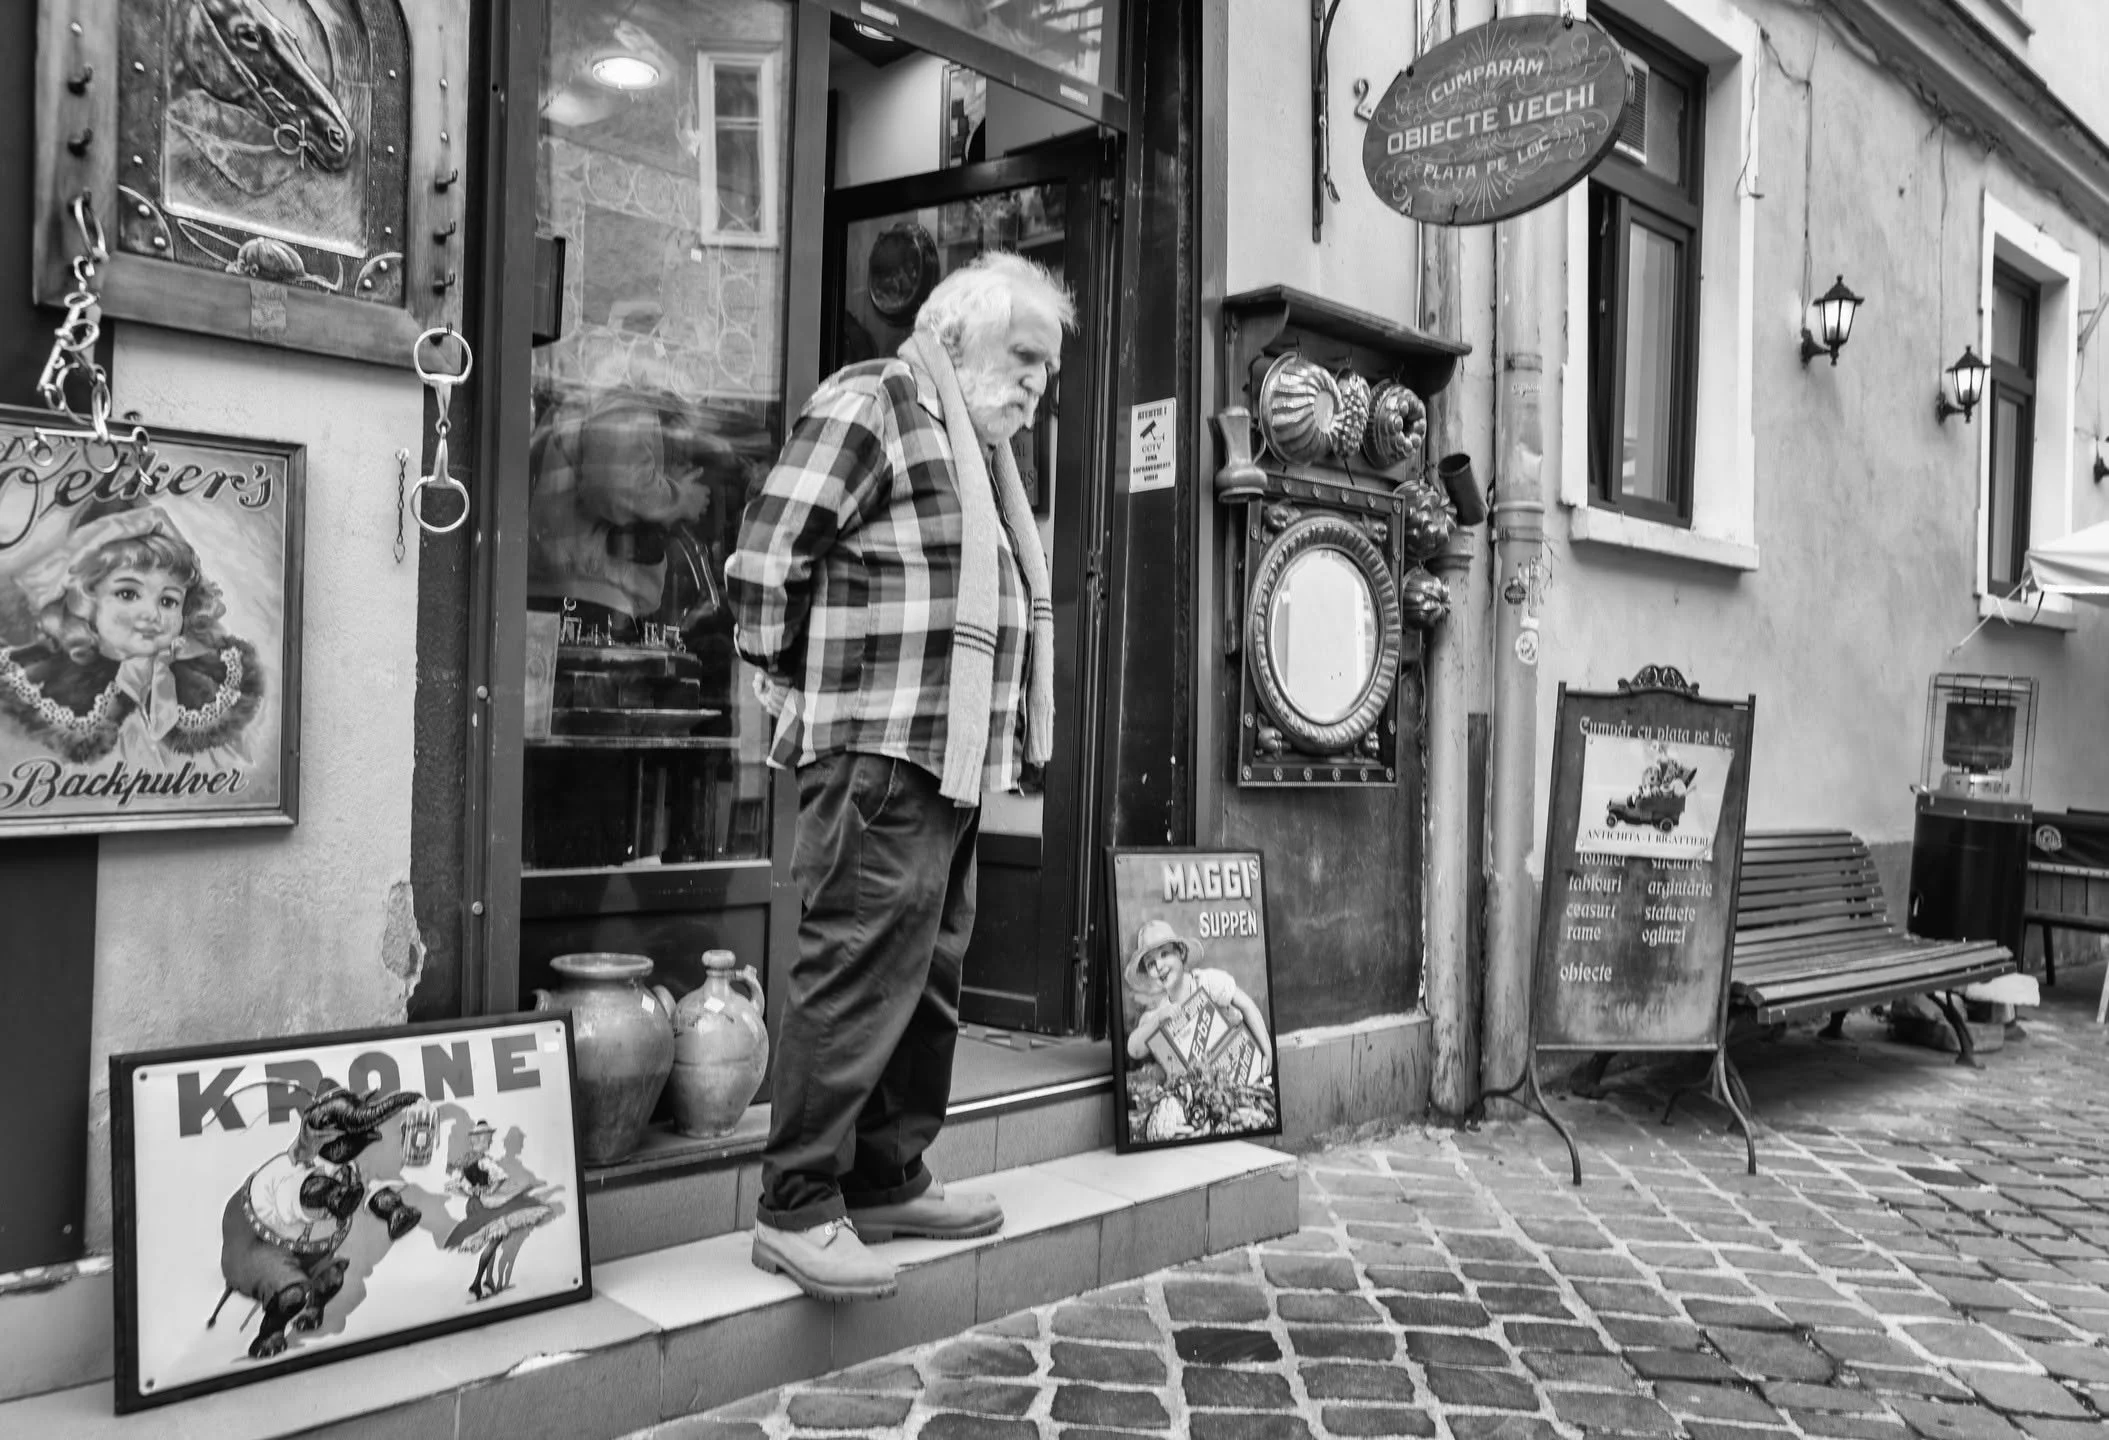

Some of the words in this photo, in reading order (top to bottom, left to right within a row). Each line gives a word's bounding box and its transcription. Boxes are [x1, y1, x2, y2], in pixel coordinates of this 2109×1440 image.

[1430, 57, 1545, 104] CUMPARAM
[1387, 107, 1499, 156] OBIECTE
[1508, 82, 1596, 126] VECHI
[1423, 163, 1477, 181] PLATA
[1486, 153, 1508, 176] PE
[1517, 135, 1552, 164] LOC
[1637, 725, 1652, 740] cu
[1714, 728, 1732, 746] loc
[0, 758, 249, 810] Backpulver
[1568, 870, 1623, 893] tablouri
[1199, 910, 1259, 938] SUPPEN
[1566, 903, 1616, 919] ceasuri
[1644, 903, 1697, 922] statuete
[1566, 926, 1602, 941] rame
[1642, 925, 1686, 947] oglinzi
[1560, 961, 1613, 983] obiecte
[177, 1033, 542, 1138] KRONE
